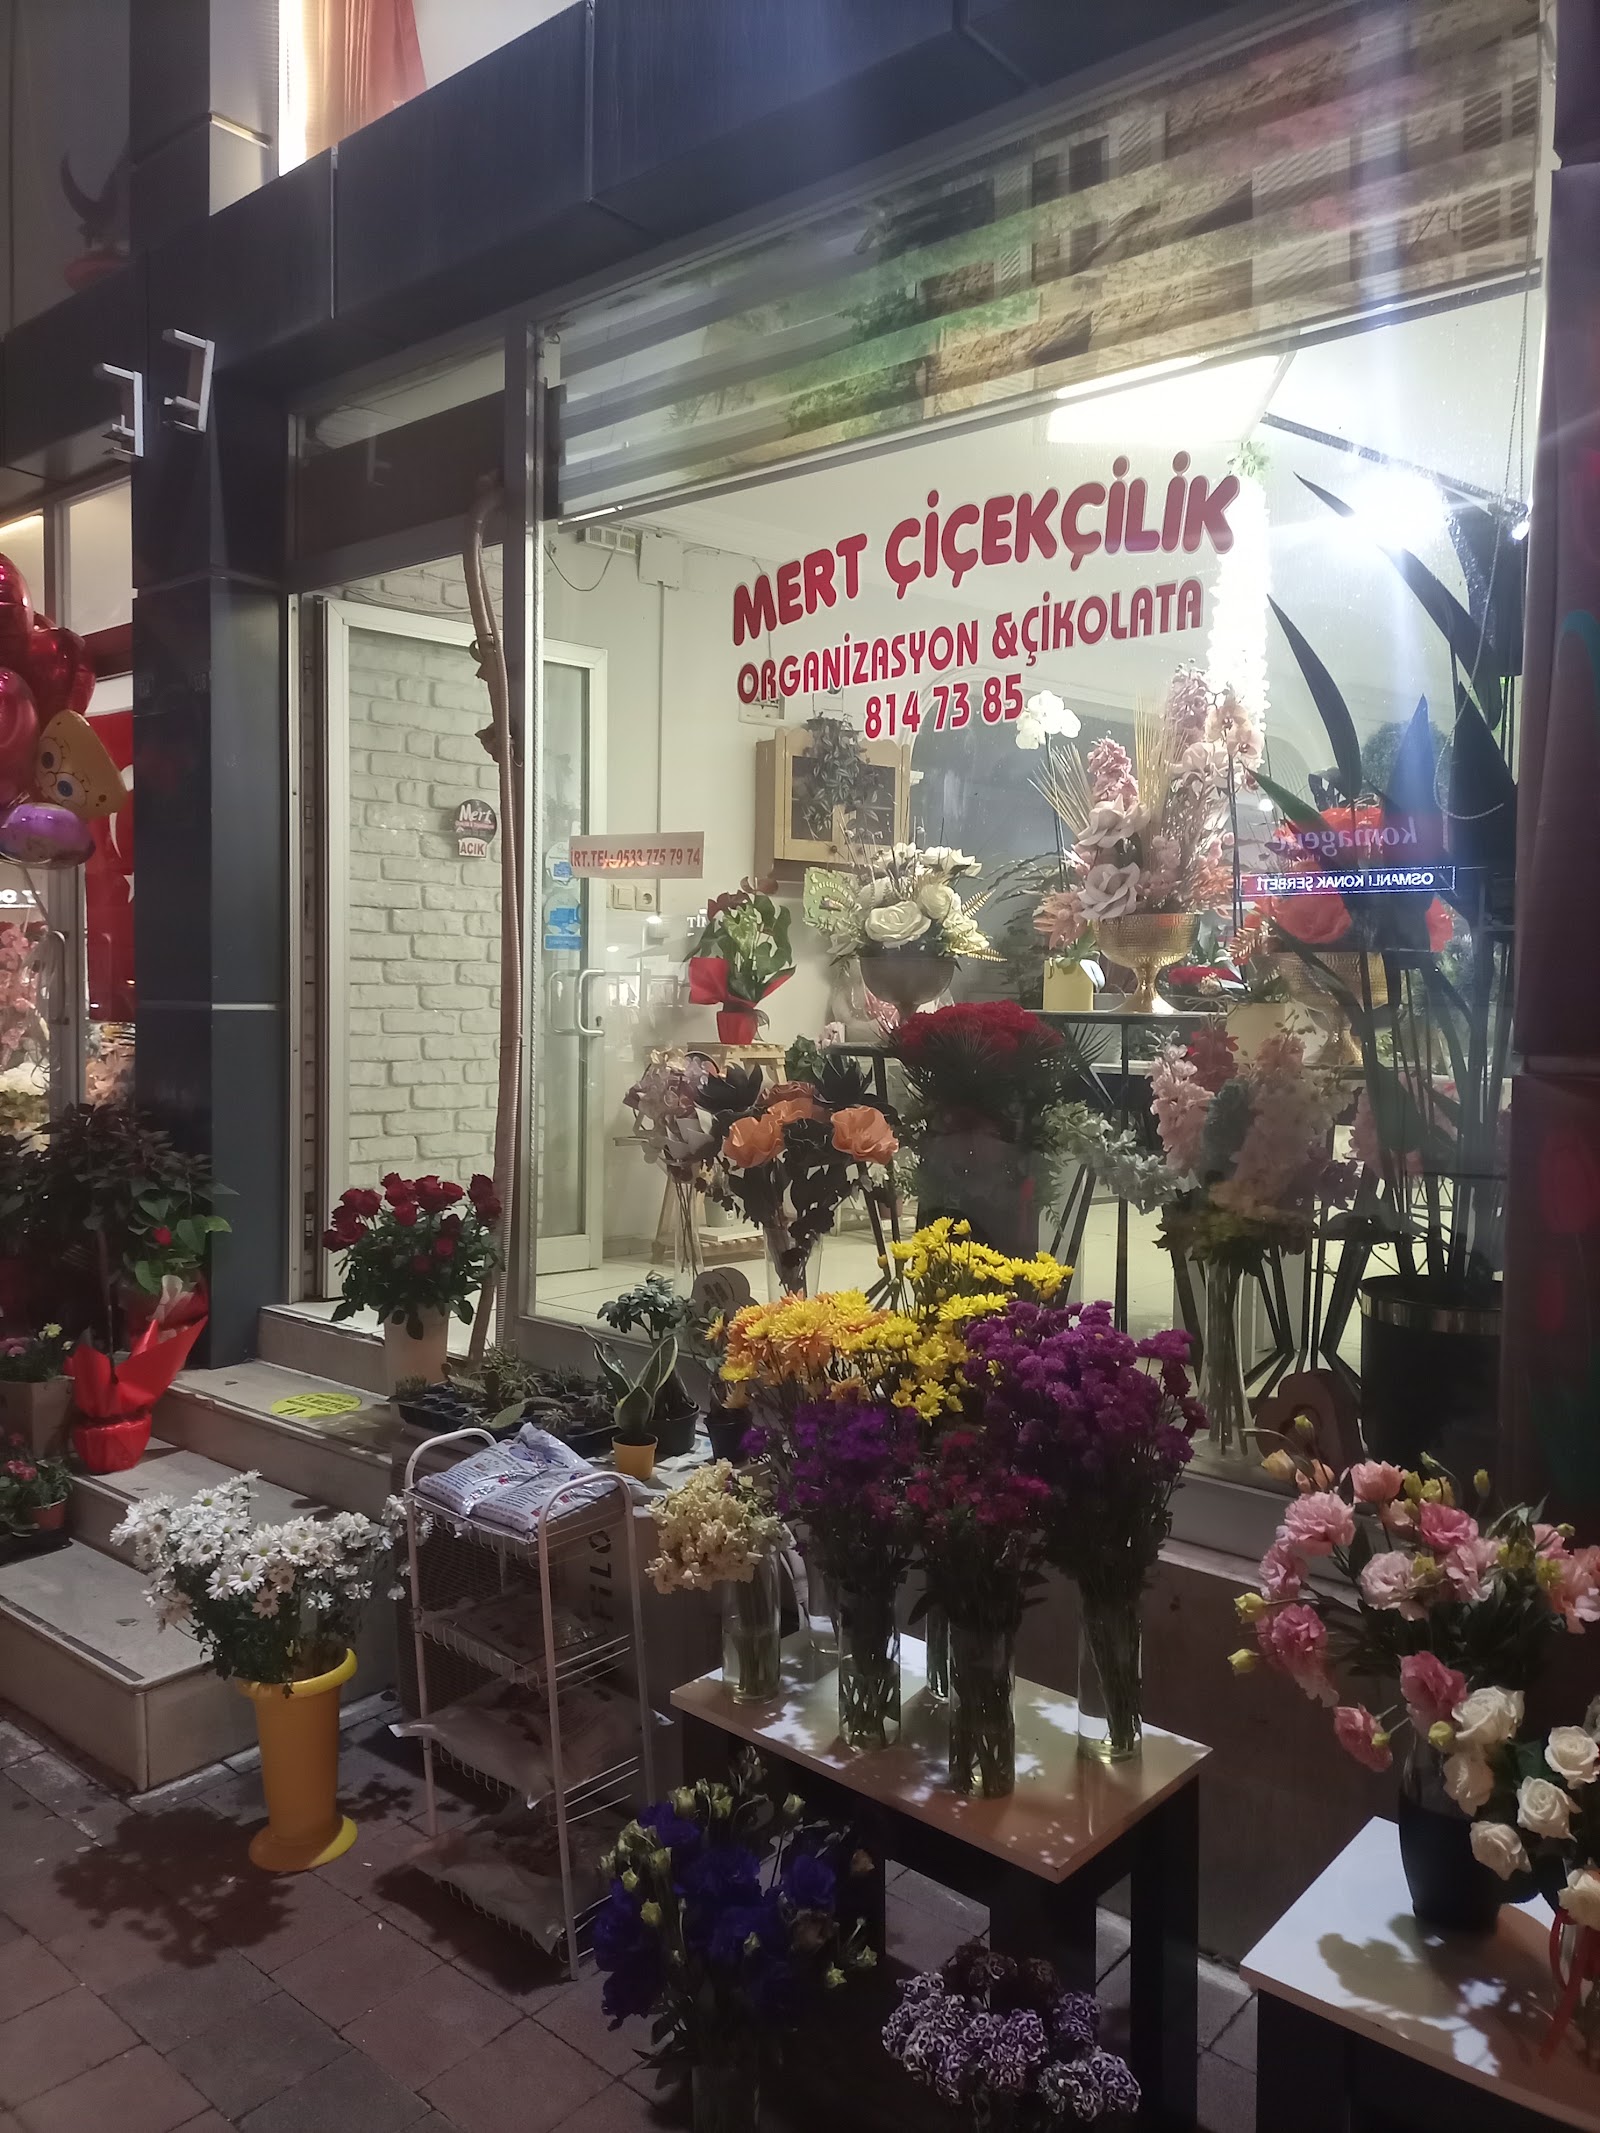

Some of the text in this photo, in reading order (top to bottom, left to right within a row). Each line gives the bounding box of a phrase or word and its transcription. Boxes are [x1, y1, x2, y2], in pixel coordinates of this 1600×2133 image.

[733, 450, 1241, 646] MERT ÇİÇEKÇİLİK
[737, 621, 979, 704] ORGANİZASYON
[864, 674, 1025, 740] 814 73 85
[459, 803, 492, 824] Mert
[646, 848, 667, 866] 775
[670, 848, 683, 866] 79
[687, 847, 701, 866] 74
